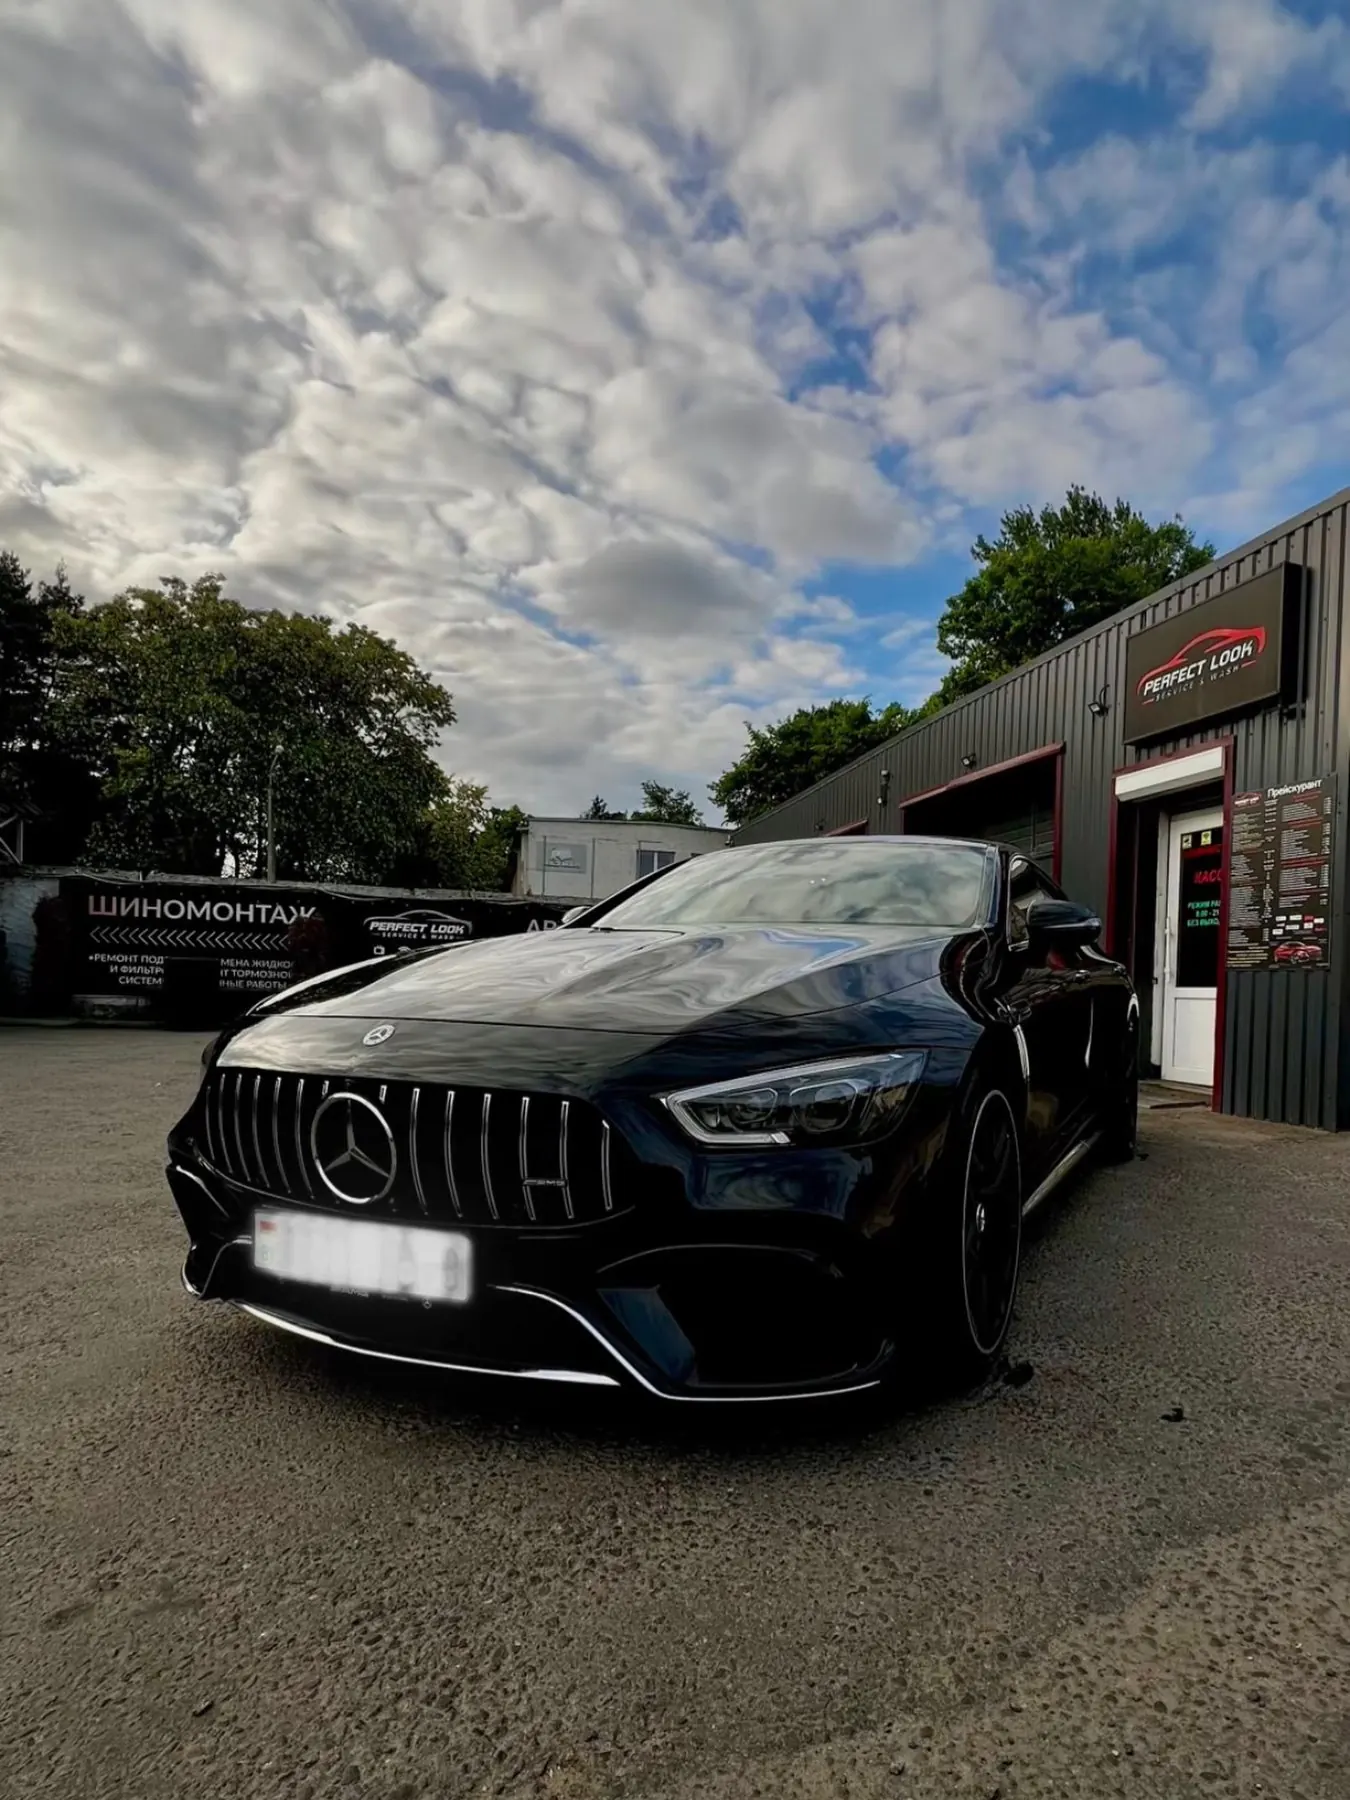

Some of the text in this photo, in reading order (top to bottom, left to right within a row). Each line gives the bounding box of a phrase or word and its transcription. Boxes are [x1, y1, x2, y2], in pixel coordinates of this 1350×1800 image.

[1143, 639, 1254, 696] PERFECT LOOK
[1267, 779, 1323, 799] Прейскурант
[88, 895, 317, 925] ШИНОМОНТАЖ
[369, 921, 466, 935] PERFECT LOOK
[140, 955, 165, 965] ПОД
[109, 964, 119, 974] И
[118, 975, 164, 985] СИСТЕМ
